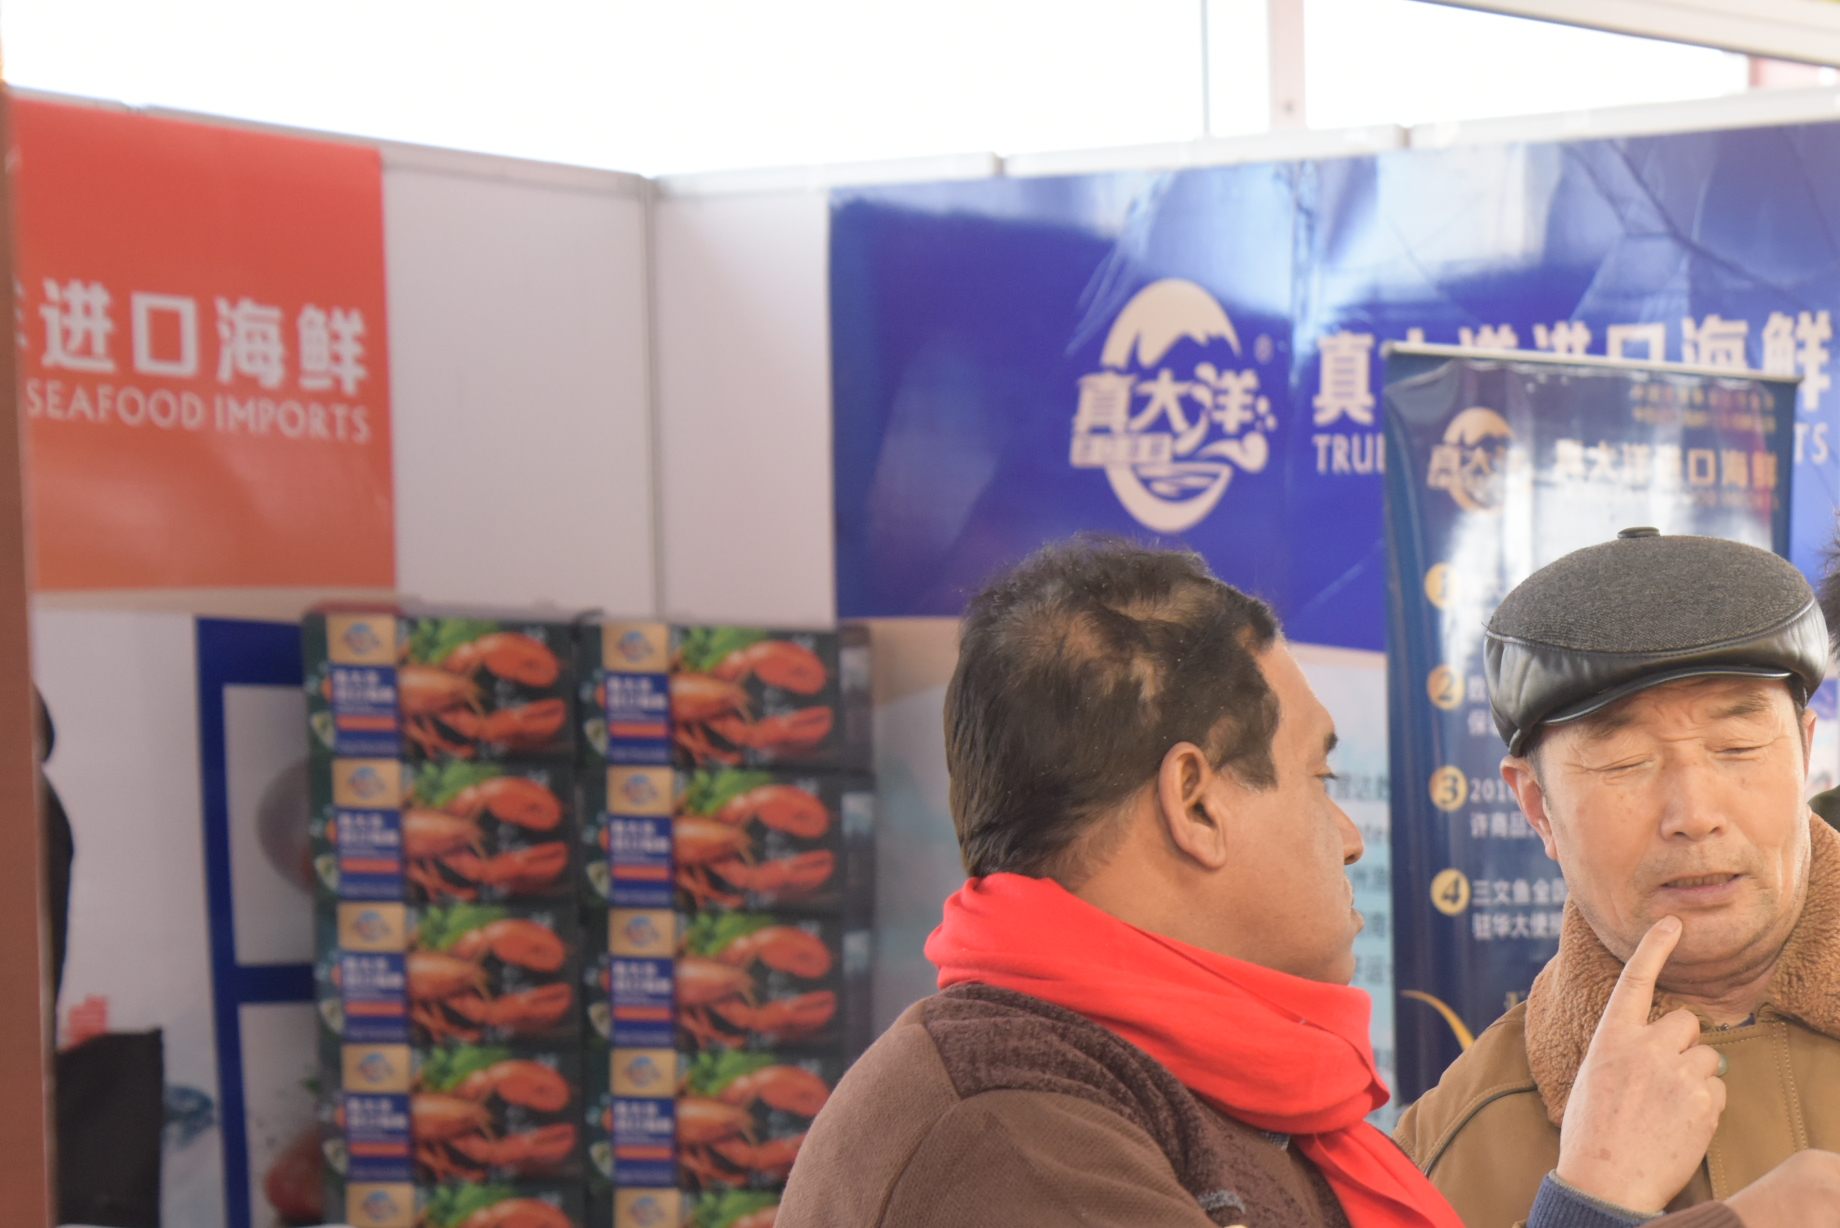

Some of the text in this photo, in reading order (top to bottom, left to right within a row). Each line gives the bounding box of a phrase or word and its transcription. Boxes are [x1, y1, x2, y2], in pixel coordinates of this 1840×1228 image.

[15, 276, 370, 396] 进口海鲜
[26, 377, 371, 444] SEAFOOD IMPORTS
